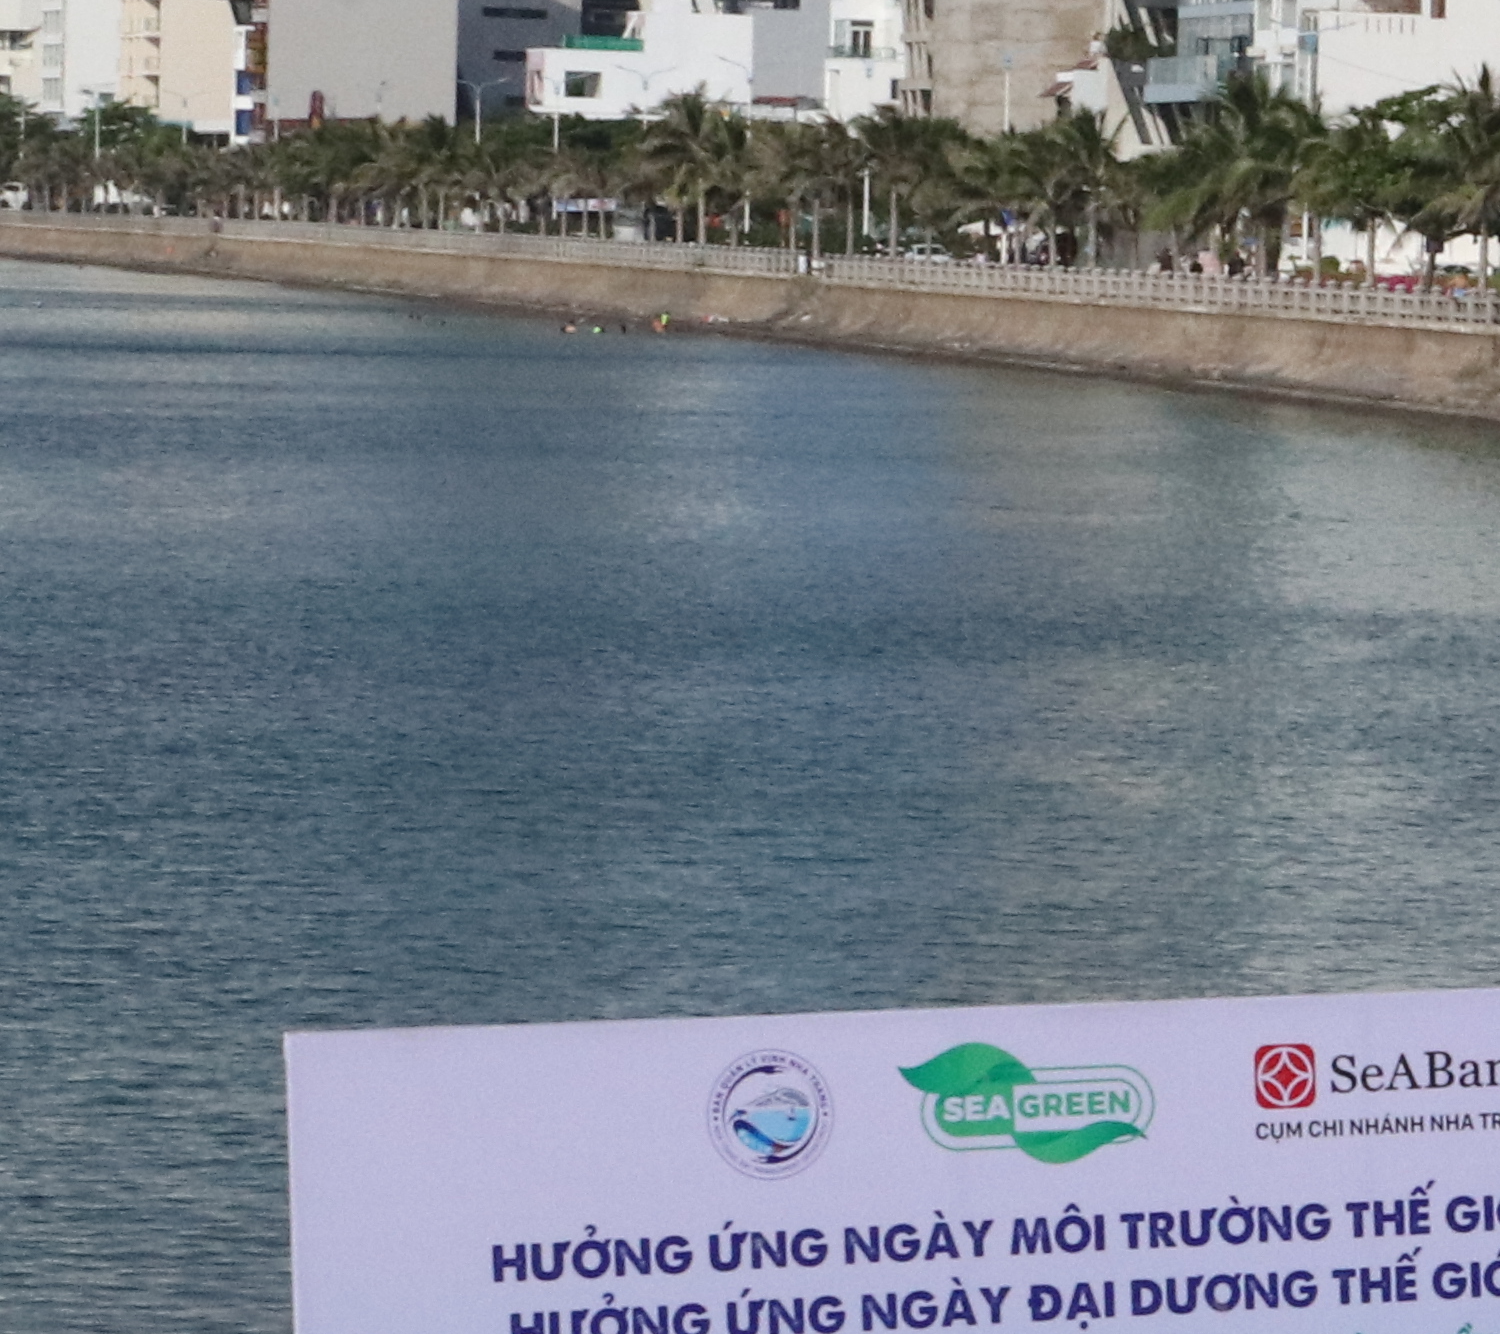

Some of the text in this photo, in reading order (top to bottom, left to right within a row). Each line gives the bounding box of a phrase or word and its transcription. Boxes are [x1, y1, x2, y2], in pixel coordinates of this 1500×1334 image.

[943, 1090, 1131, 1123] SEA GREEN
[1255, 1122, 1302, 1144] CỤM
[1308, 1119, 1344, 1139] CHI
[1350, 1113, 1425, 1136] NHÁNH
[1430, 1112, 1476, 1134] NHA
[492, 1224, 693, 1283] HƯỞNG
[708, 1220, 828, 1272] ỨNG
[844, 1210, 993, 1265] NGÀY
[1010, 1203, 1105, 1255] MÔI
[1119, 1195, 1332, 1250] TRƯỜNG
[1345, 1180, 1435, 1238] THẾ
[861, 1276, 1011, 1332] NGÀY
[1027, 1280, 1115, 1330] ĐẠI
[1130, 1270, 1318, 1316] DƯƠNG
[1331, 1246, 1421, 1305] THẾ
